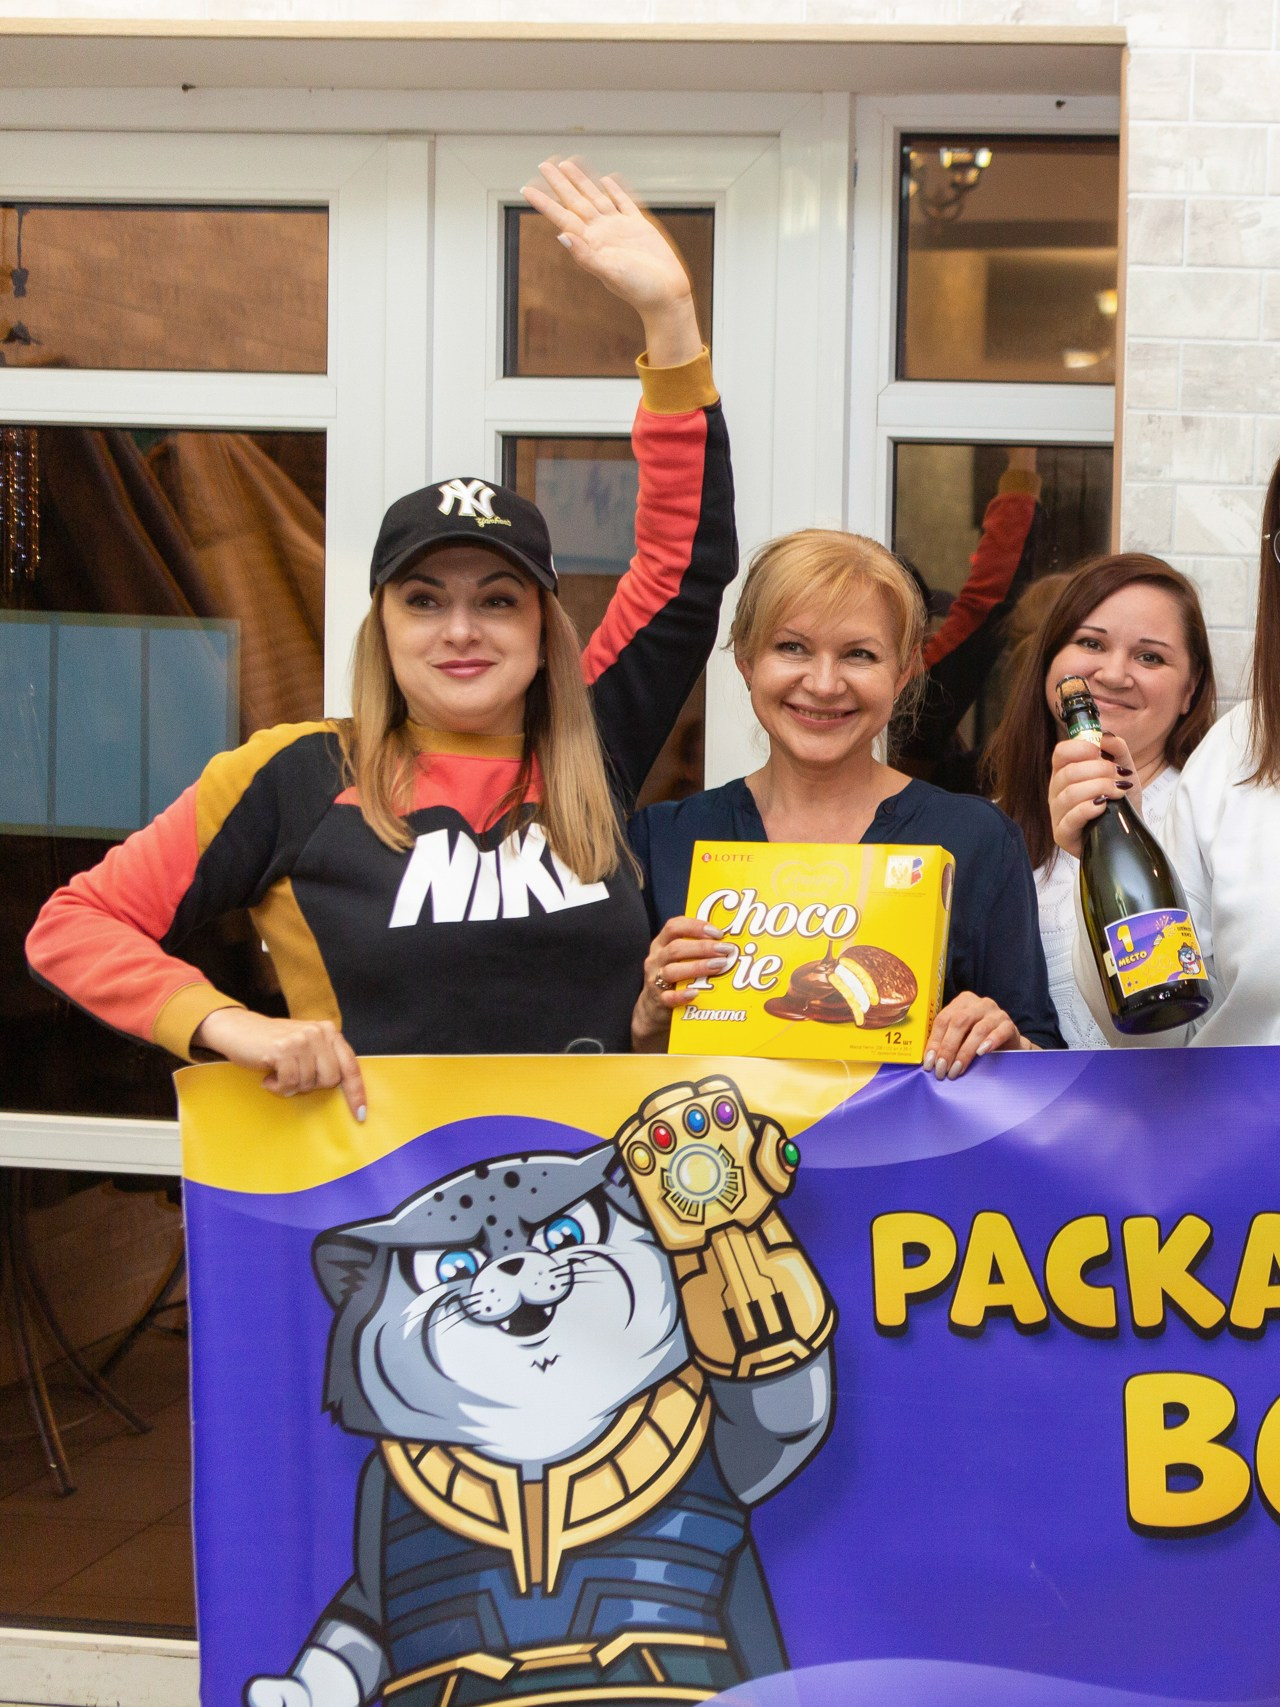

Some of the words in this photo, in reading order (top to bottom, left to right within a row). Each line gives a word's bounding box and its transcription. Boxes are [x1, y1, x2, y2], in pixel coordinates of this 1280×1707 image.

[438, 479, 497, 518] NY
[714, 853, 755, 863] LOTTE
[695, 888, 862, 938] Choco
[1117, 924, 1135, 953] 1
[1118, 950, 1148, 968] МЕСТО
[682, 1005, 747, 1022] Banana
[884, 1031, 902, 1045] 12
